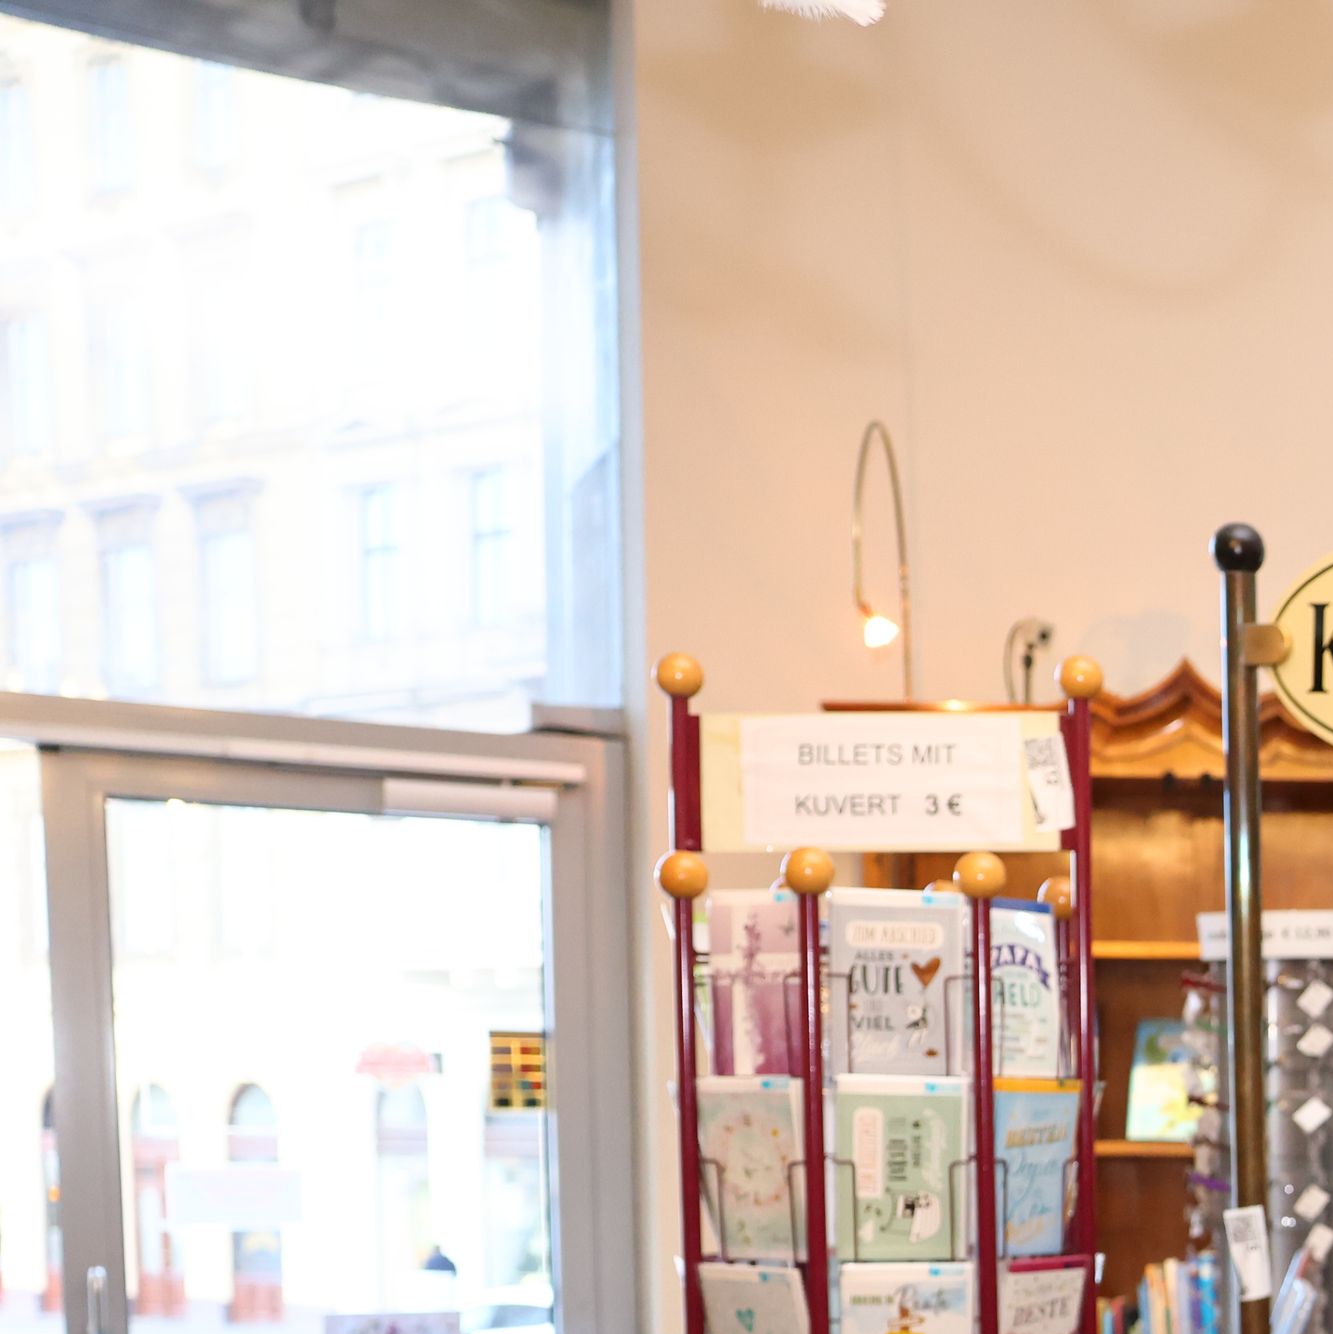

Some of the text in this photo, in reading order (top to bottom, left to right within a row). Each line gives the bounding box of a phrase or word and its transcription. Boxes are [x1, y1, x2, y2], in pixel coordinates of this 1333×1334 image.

[797, 743, 956, 766] BILLETS MIT
[794, 794, 962, 816] KUVERT 3 €
